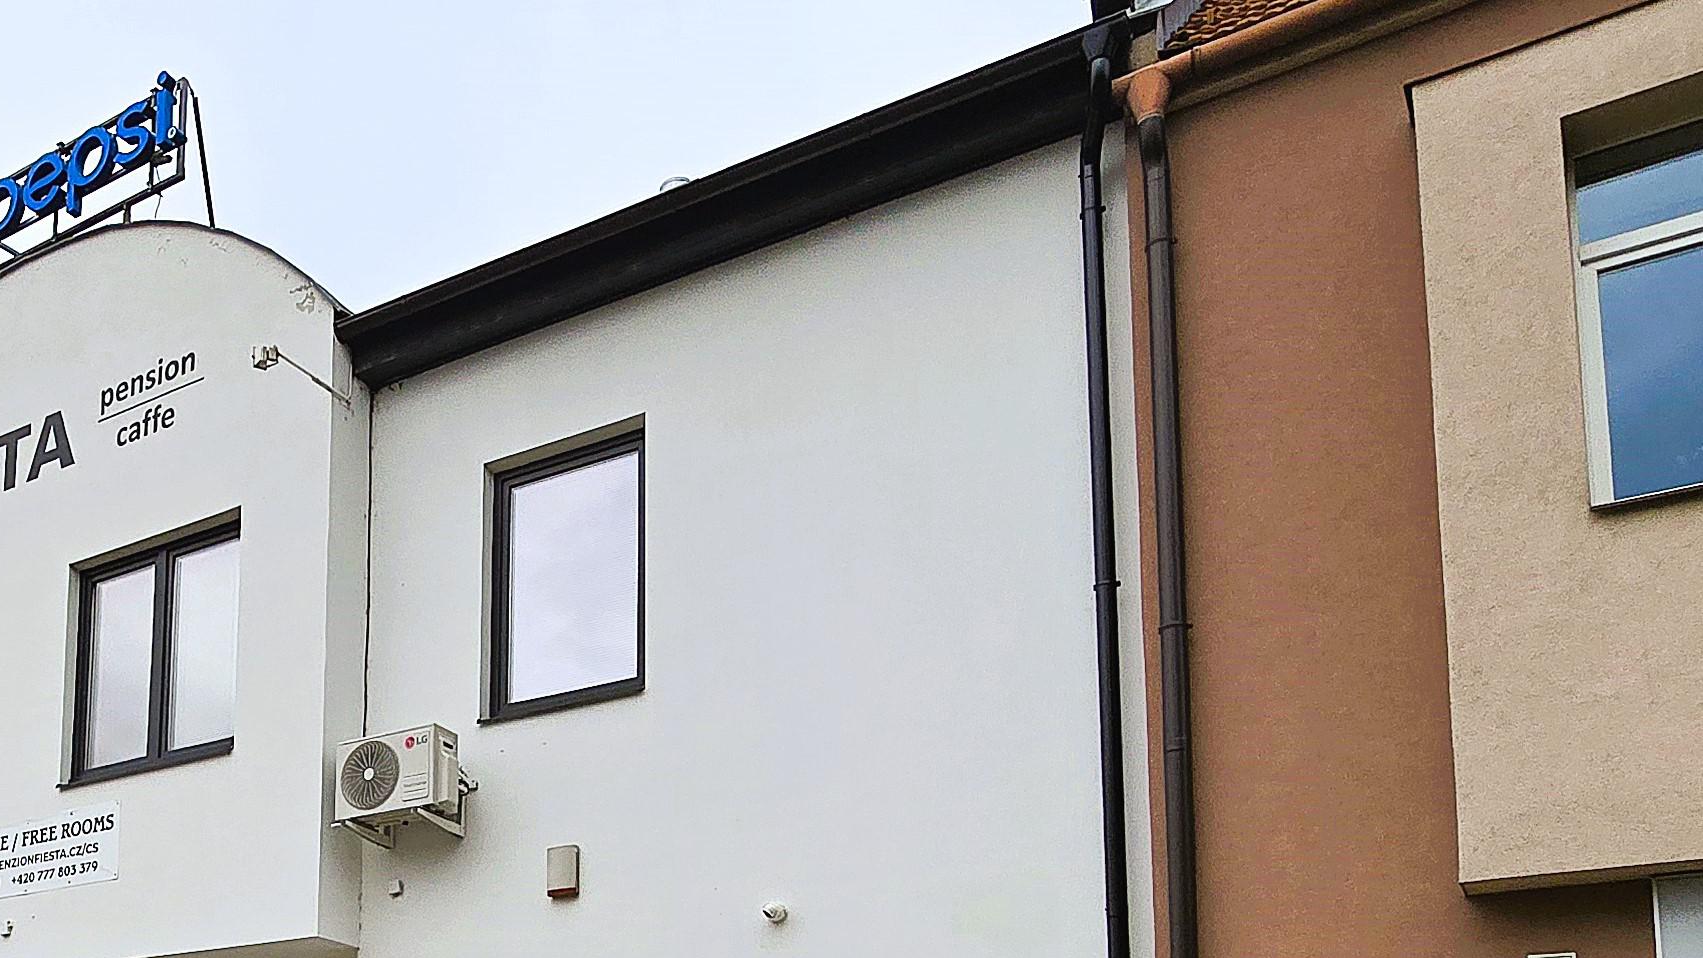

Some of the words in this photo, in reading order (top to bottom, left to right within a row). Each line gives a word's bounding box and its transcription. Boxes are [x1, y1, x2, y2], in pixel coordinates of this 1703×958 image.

[100, 351, 196, 415] pension
[116, 404, 176, 447] caffe
[416, 735, 428, 746] LG
[12, 833, 18, 853] /
[22, 825, 58, 847] FREE
[61, 814, 114, 839] ROOMS
[11, 872, 35, 885] +420
[37, 868, 55, 881] 777
[58, 864, 76, 878] 803
[79, 860, 98, 874] 379
